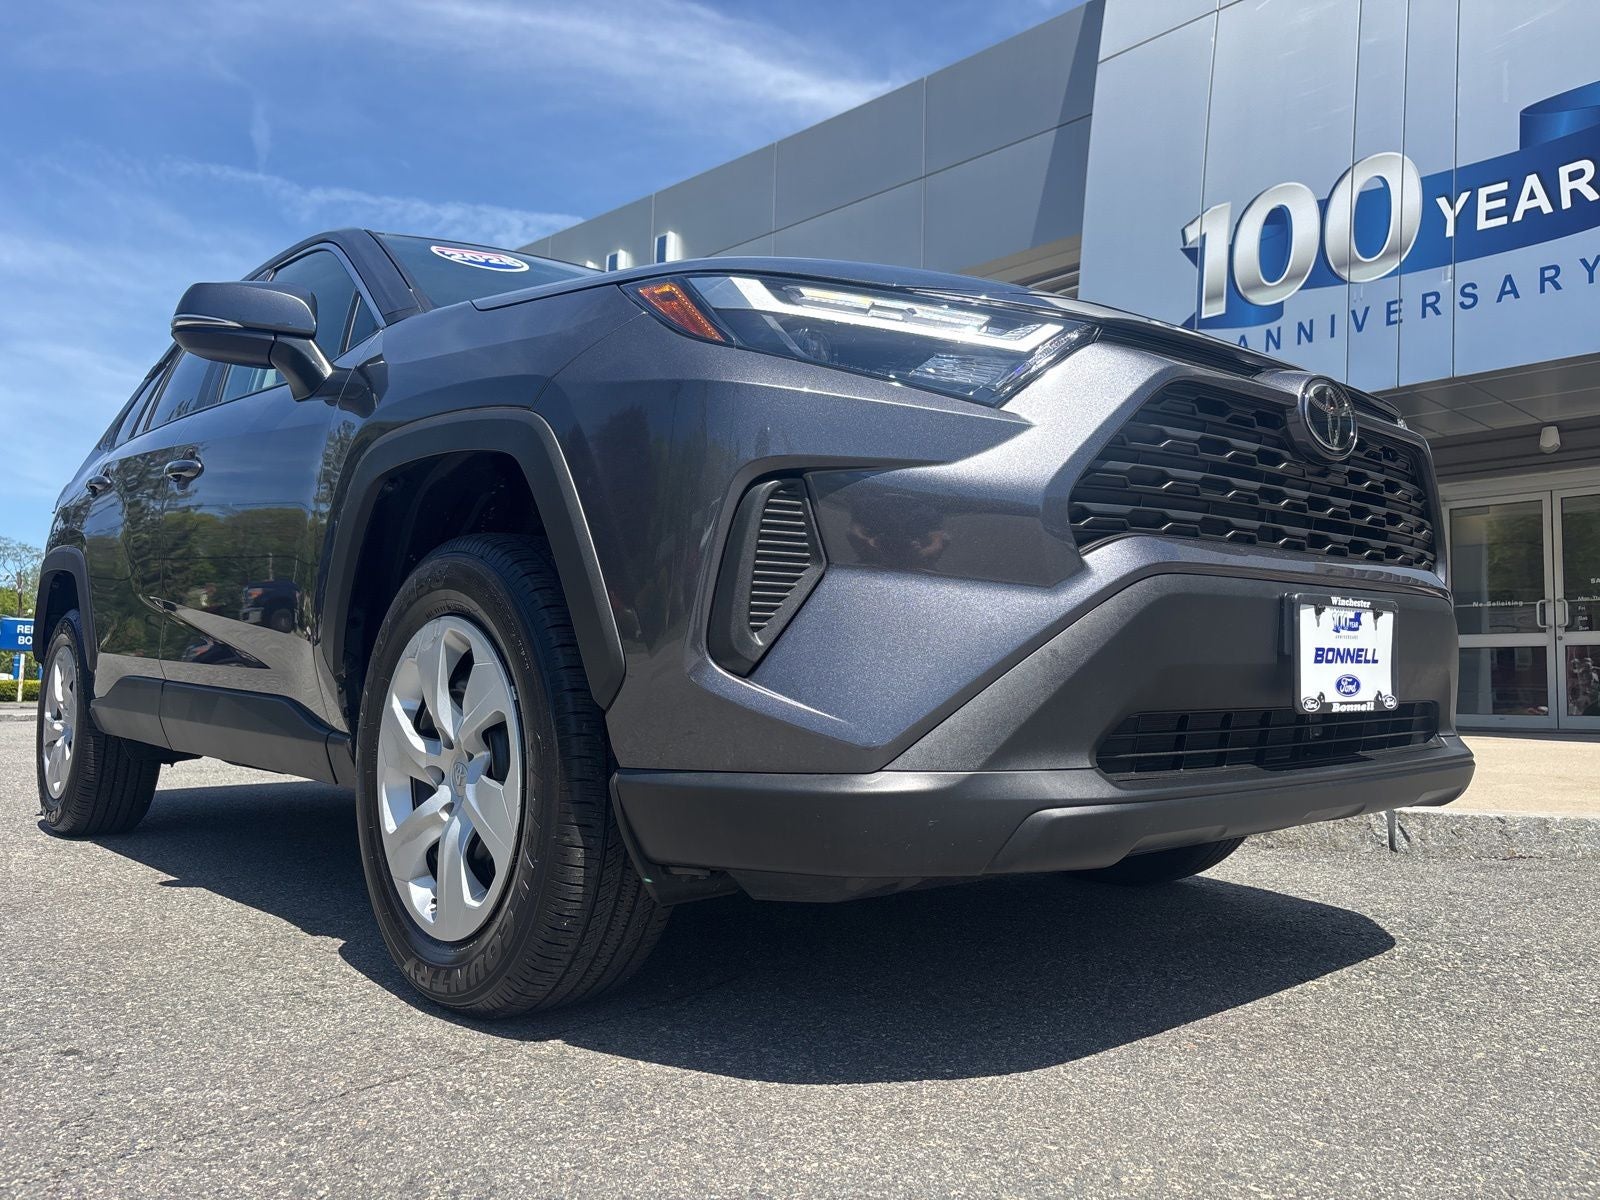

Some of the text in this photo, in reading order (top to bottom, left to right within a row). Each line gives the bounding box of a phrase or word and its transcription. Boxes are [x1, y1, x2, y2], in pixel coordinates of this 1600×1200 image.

[1182, 152, 1600, 319] 100 YEAR
[1330, 596, 1371, 608] Winchester
[16, 624, 34, 634] RE
[1313, 647, 1379, 664] BONNELL
[1339, 677, 1358, 694] Ford
[1331, 701, 1376, 713] Bonnell
